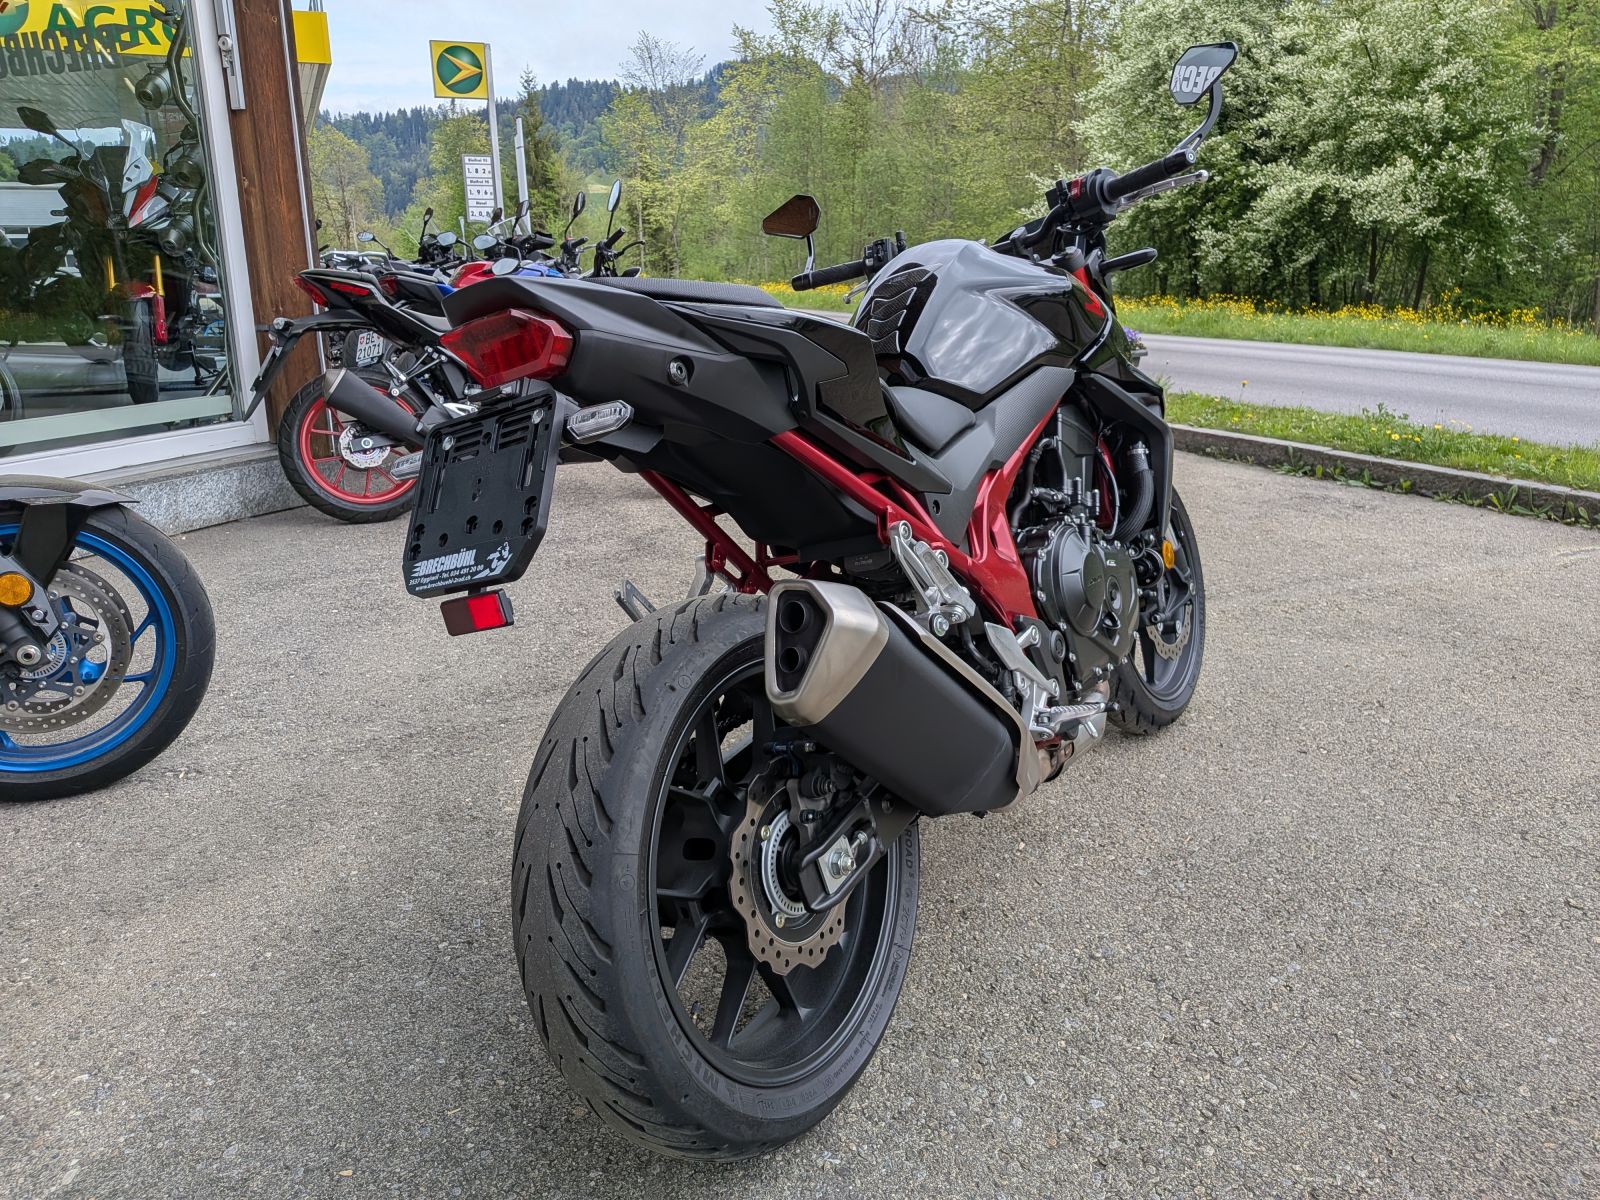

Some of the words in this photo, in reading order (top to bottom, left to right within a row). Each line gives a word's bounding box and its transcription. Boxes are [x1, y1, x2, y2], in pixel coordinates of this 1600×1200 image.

[366, 332, 375, 344] BE
[357, 344, 380, 360] 21071
[416, 548, 476, 576] BRECHBÜHL
[904, 828, 913, 869] ROAD
